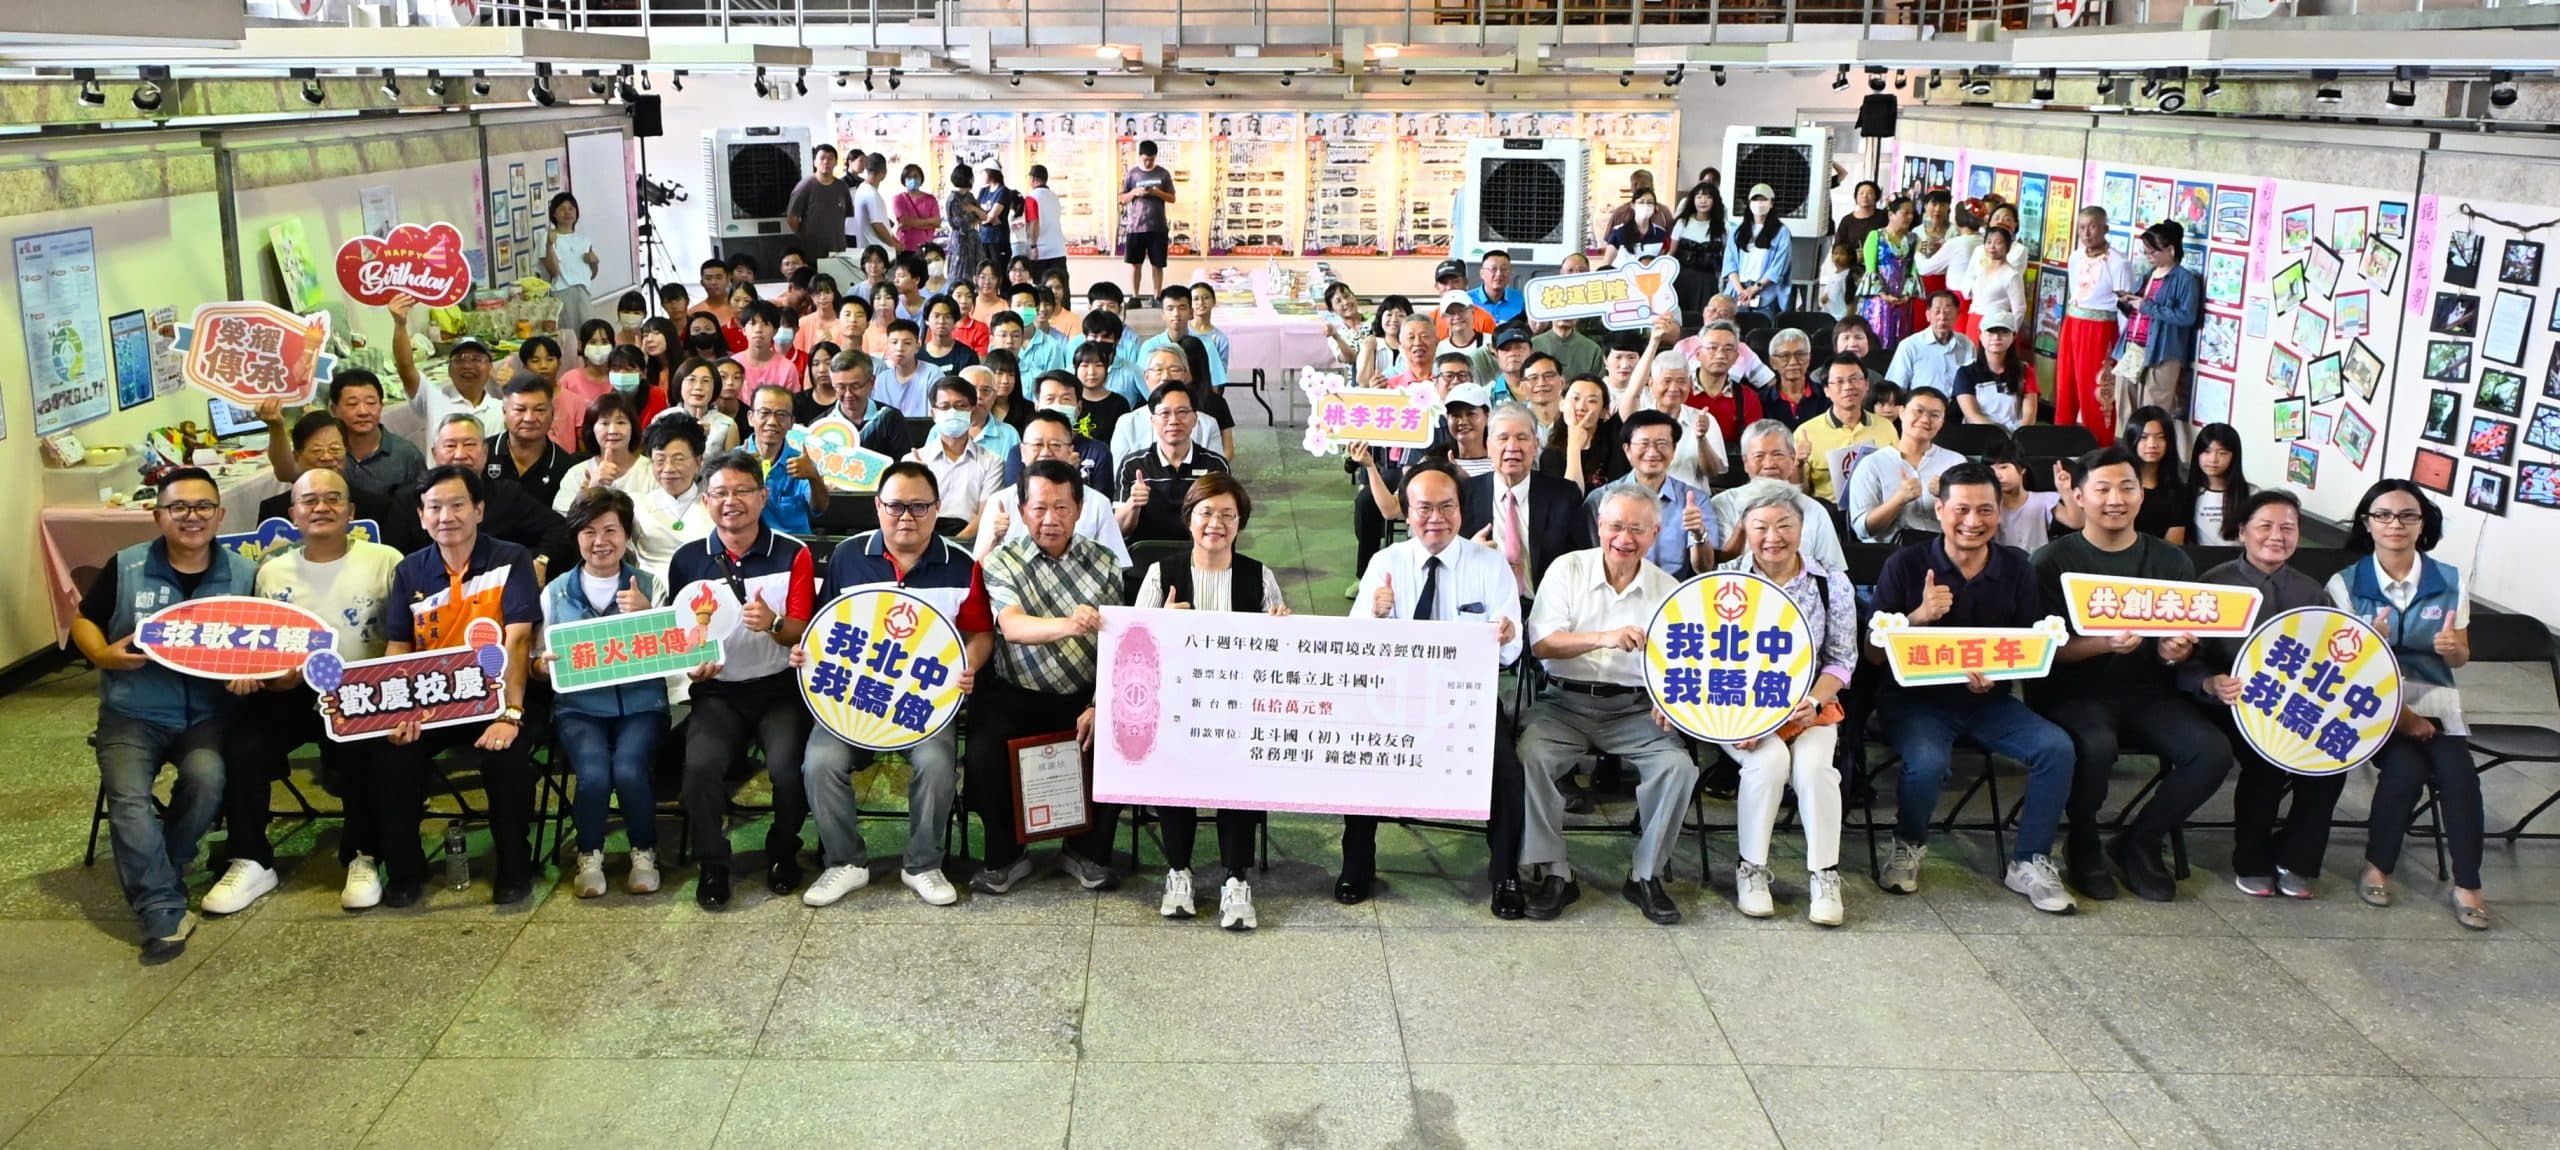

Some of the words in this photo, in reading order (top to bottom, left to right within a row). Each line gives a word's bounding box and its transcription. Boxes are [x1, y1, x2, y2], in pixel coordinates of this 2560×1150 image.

[384, 248, 425, 260] HAPPY
[359, 260, 454, 300] Birthday
[1542, 279, 1628, 309] 校運昌隆
[217, 318, 282, 354] 榮耀
[205, 346, 287, 390] 傳承
[1323, 403, 1421, 430] 桃李芬芳
[2088, 586, 2220, 624] 共創未來
[162, 619, 310, 654] 弦歌不輟
[571, 627, 688, 670] 薪火相傳
[824, 621, 949, 691] 我北中
[1666, 622, 1793, 663] 我北中
[1907, 637, 2025, 668] 邁向百年
[339, 666, 486, 716] 歡慶校慶
[1253, 669, 1385, 689] 彰化縣立北斗國中
[1663, 667, 1792, 708] 我驕傲
[2265, 634, 2382, 719] 我北中
[809, 660, 935, 733] 我驕傲
[1252, 697, 1334, 716] 伍拾萬元整
[2240, 671, 2360, 763] 我驕傲
[1249, 746, 1314, 763] 常務理事
